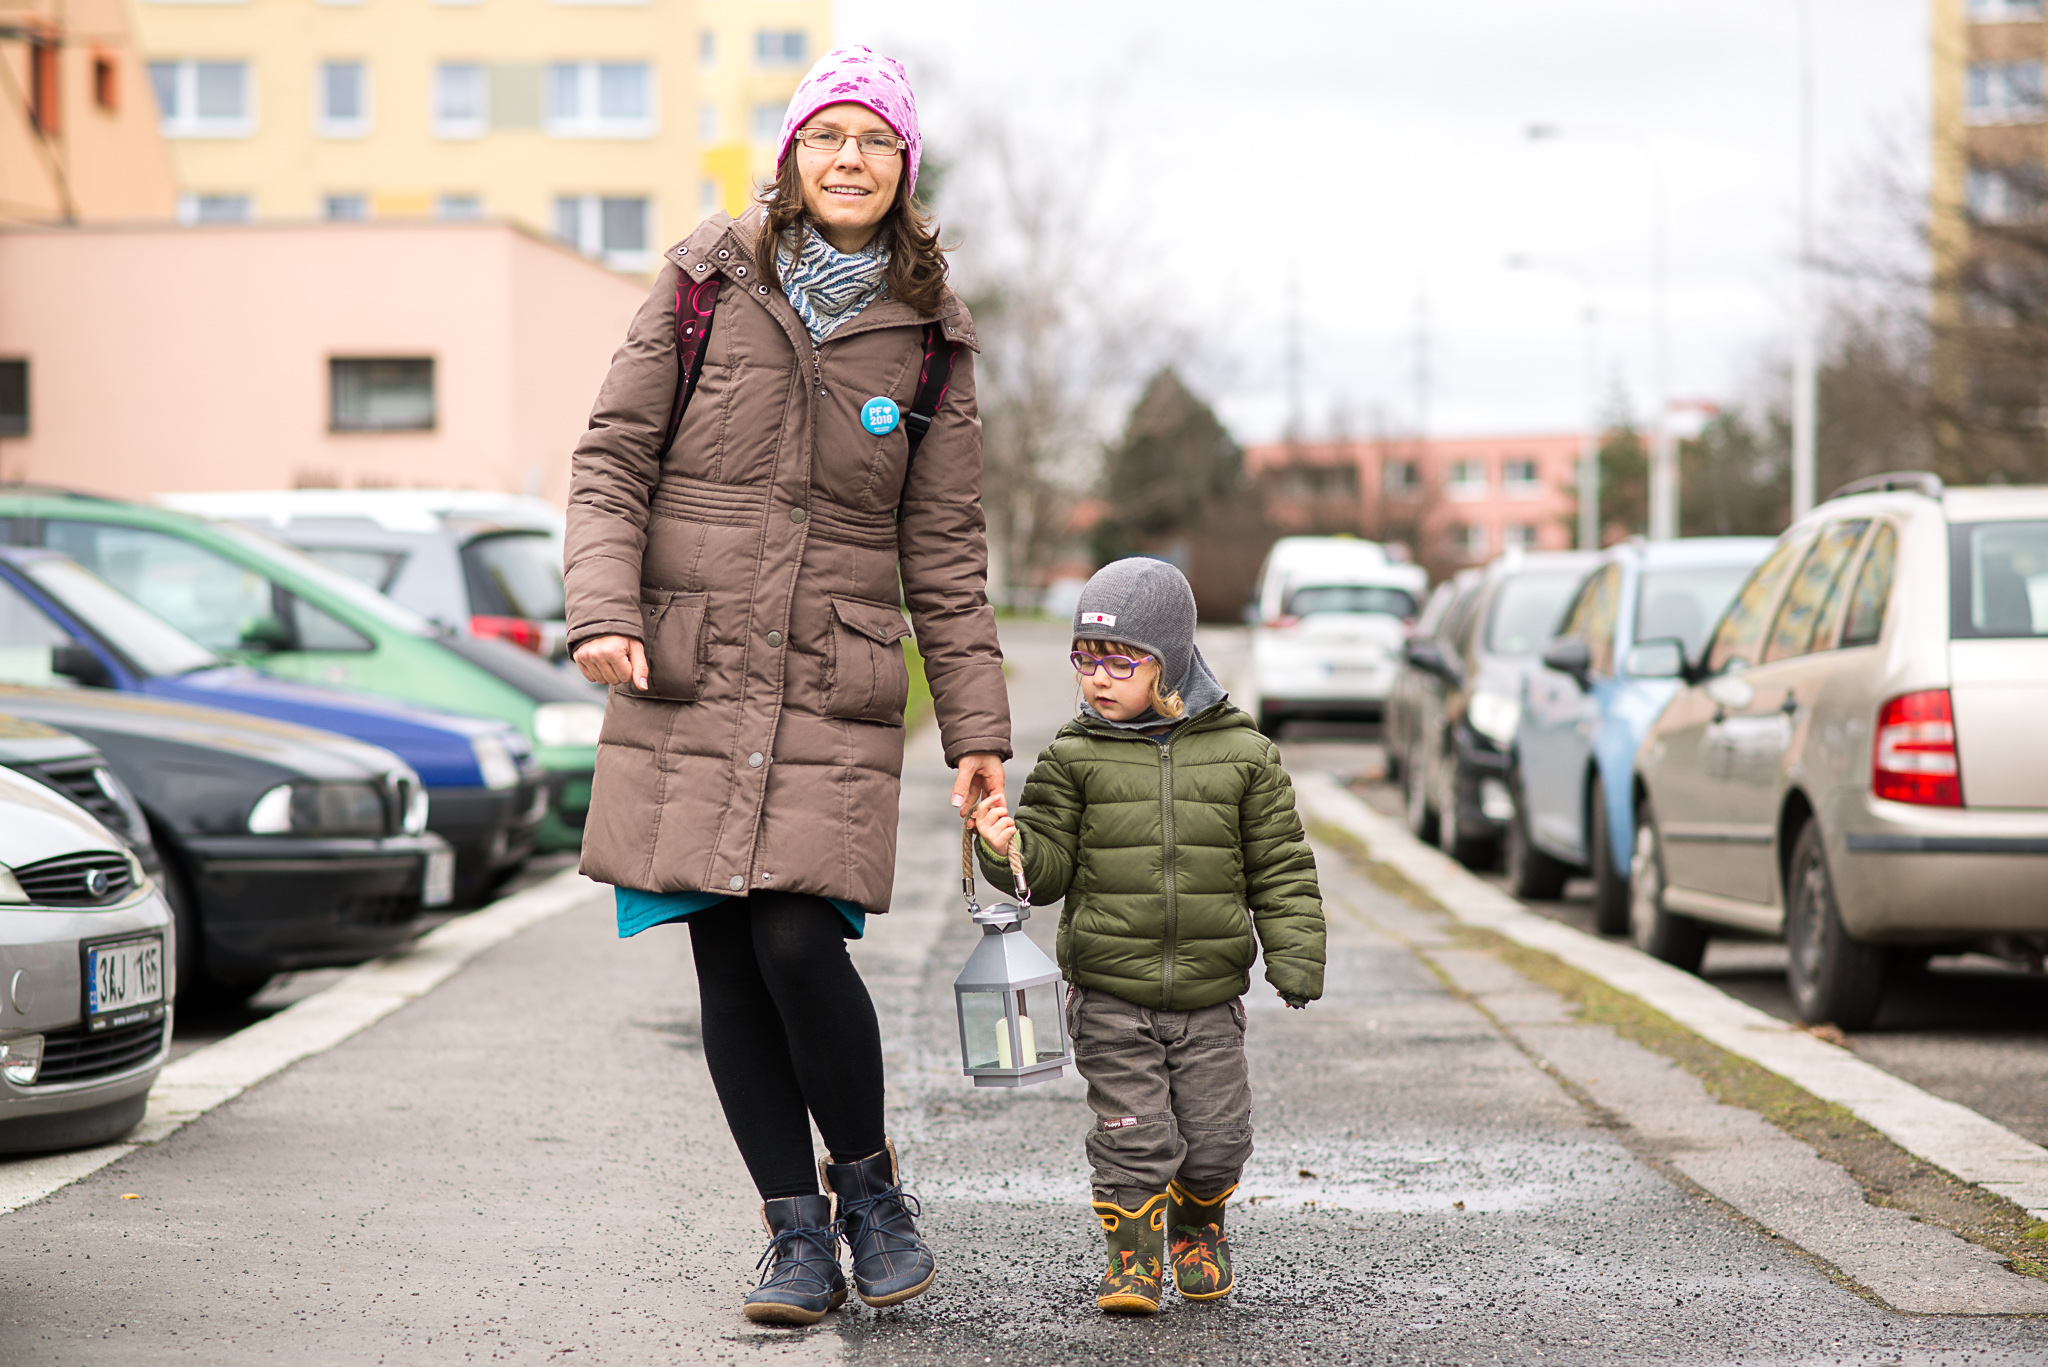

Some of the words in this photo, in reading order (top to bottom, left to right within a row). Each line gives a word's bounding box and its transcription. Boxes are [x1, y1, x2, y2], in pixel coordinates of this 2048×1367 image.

[869, 406, 882, 417] PF
[870, 414, 893, 426] 2018
[99, 953, 126, 1004] 3AJ
